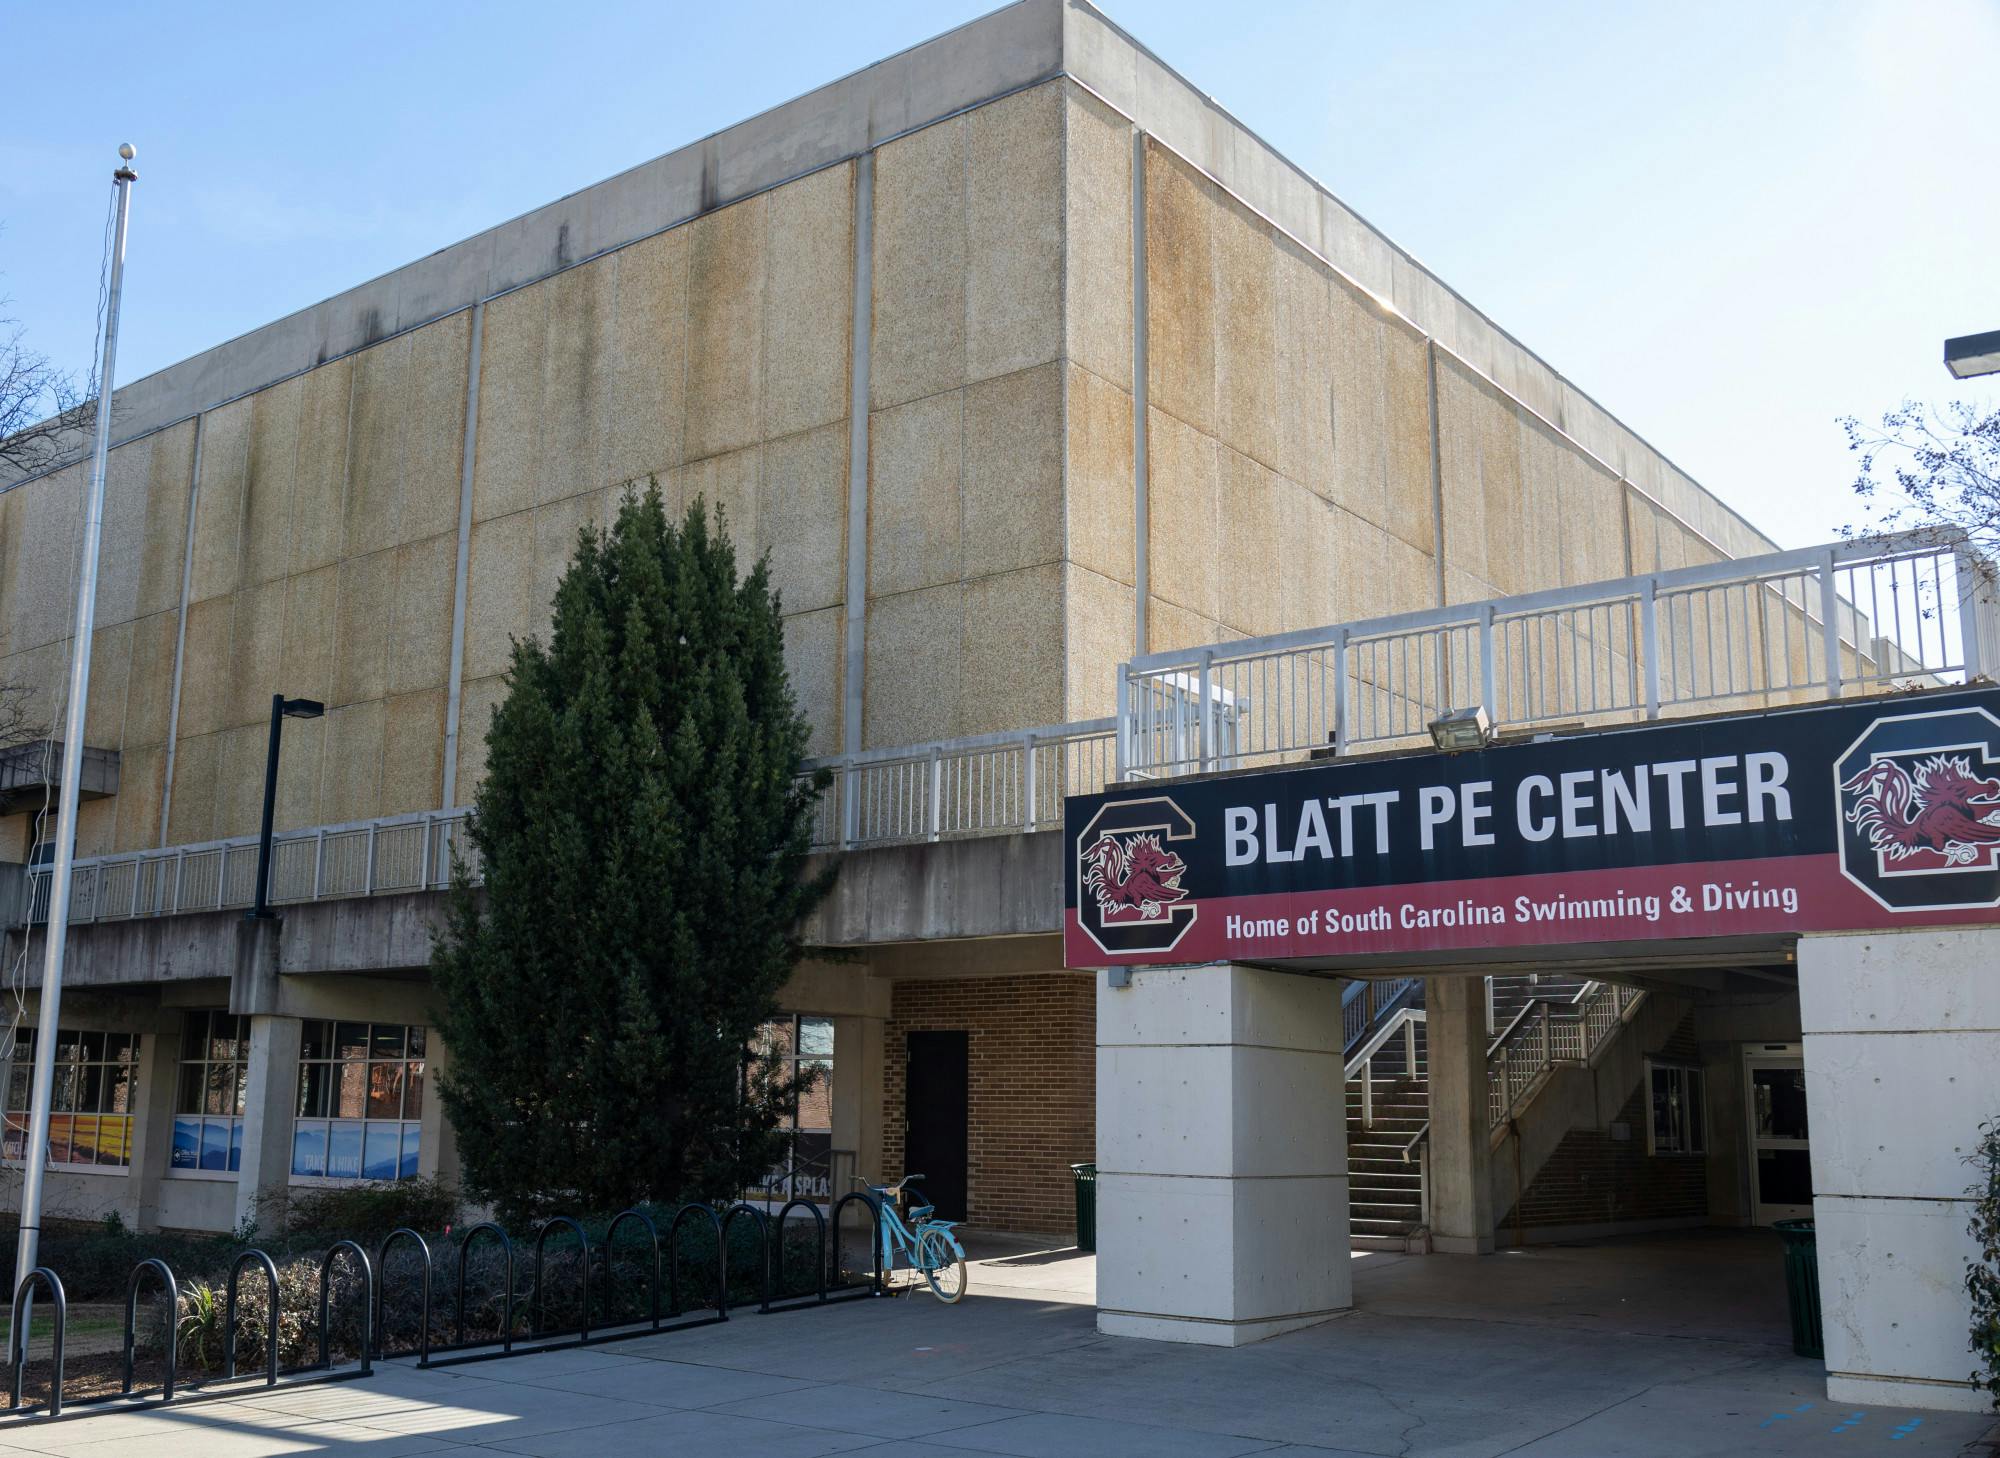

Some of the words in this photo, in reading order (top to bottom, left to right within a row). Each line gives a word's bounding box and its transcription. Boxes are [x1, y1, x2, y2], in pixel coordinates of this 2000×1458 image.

[1225, 791, 1399, 867] BLATT
[1420, 780, 1496, 850] PE
[1516, 751, 1793, 842] CENTER
[1226, 914, 1289, 939] Home
[1296, 909, 1319, 935] of
[1325, 905, 1392, 934] South
[1400, 899, 1506, 929] Carolina
[1514, 889, 1661, 922] Swimming
[1669, 885, 1694, 914] &
[1702, 880, 1799, 914] Diving
[795, 1176, 831, 1197] SPLA
